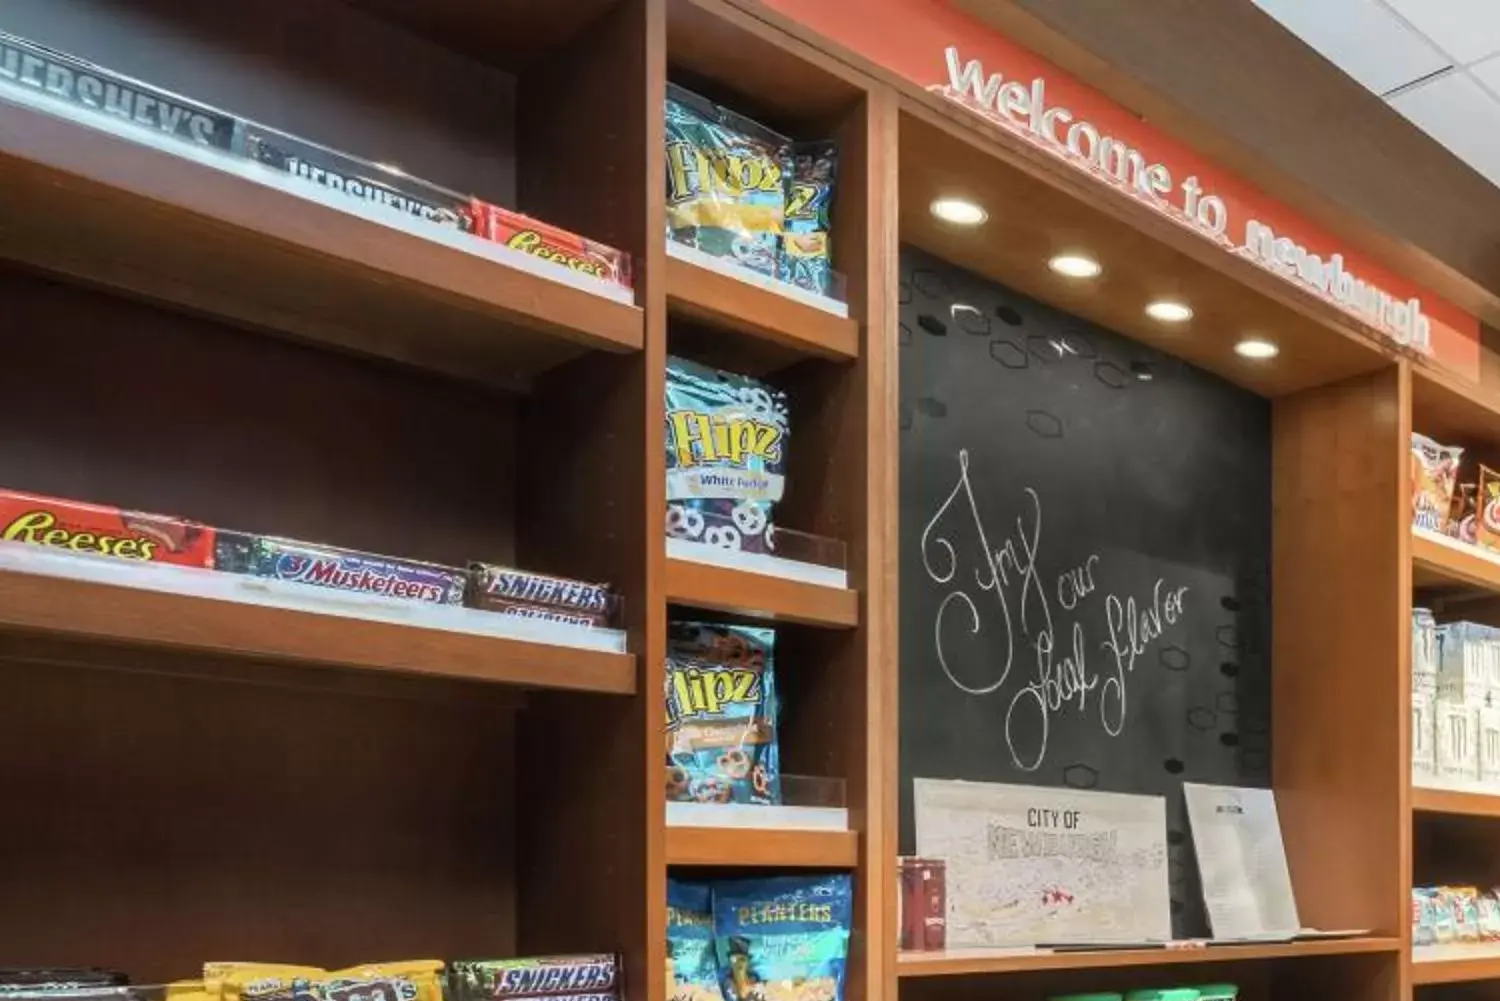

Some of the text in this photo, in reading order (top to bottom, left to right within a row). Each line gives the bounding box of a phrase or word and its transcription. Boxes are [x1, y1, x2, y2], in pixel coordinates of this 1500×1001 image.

[944, 46, 1172, 202] welcome
[1182, 176, 1228, 236] to
[670, 410, 783, 468] Flipz
[2, 510, 158, 562] Reese's
[1027, 807, 1080, 830] CITY OF
